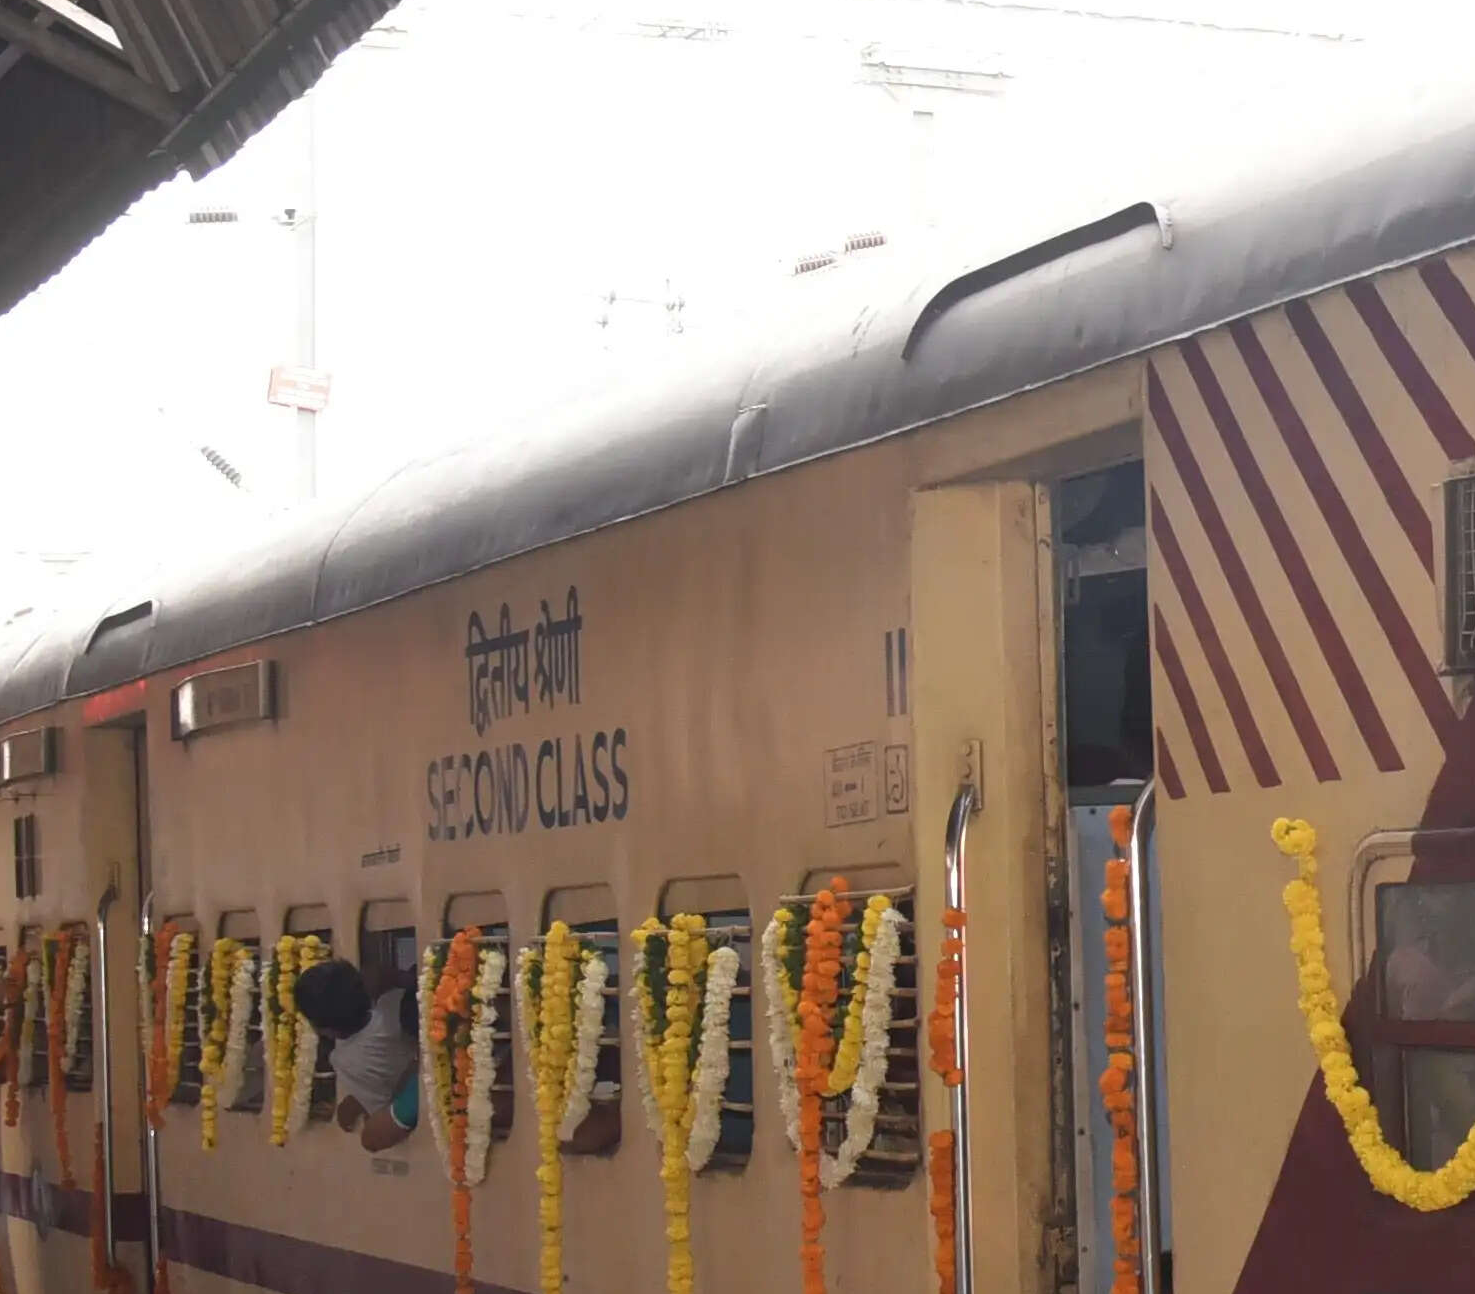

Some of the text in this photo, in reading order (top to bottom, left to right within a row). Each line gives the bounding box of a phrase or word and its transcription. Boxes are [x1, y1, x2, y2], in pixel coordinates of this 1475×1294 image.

[465, 585, 583, 738] द्वितीय श्रेणी
[428, 728, 629, 841] SECOND CLASS
